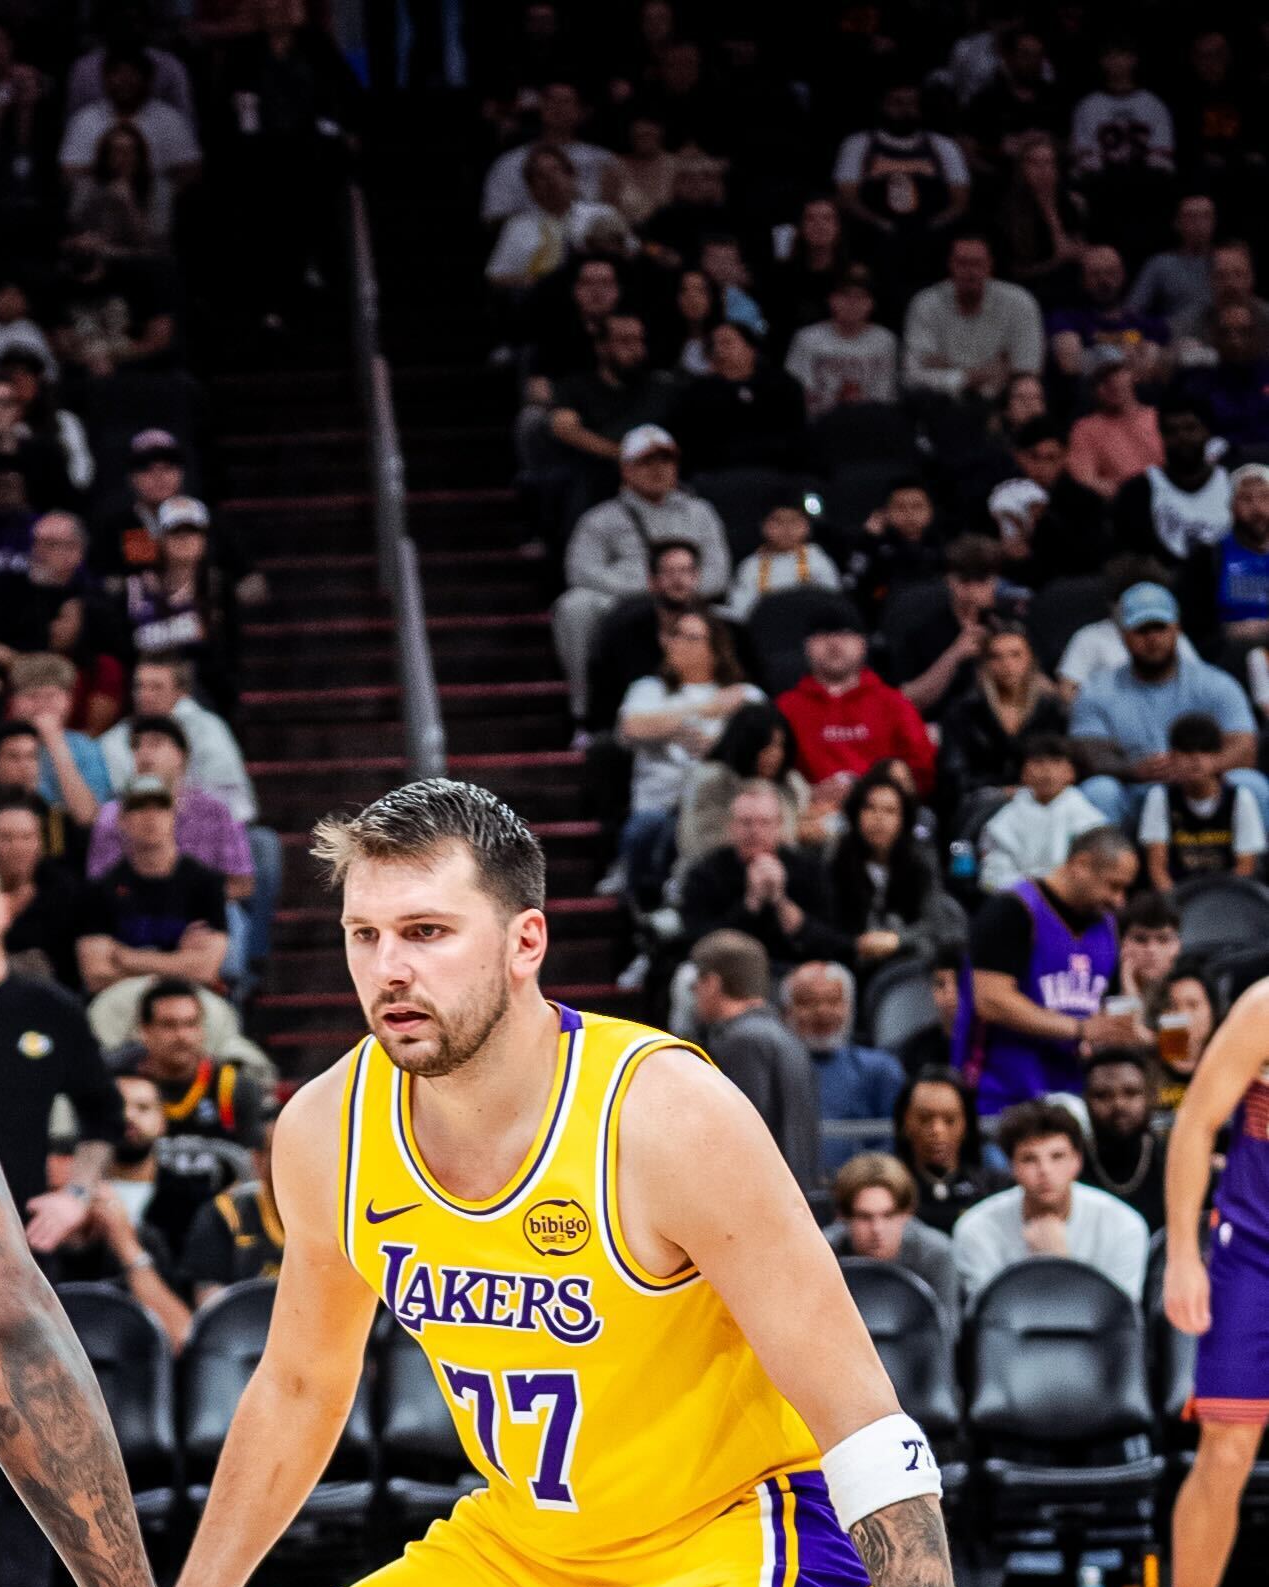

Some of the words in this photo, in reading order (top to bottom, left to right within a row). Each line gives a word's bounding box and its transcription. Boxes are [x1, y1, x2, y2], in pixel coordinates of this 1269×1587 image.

[529, 1214, 587, 1239] bibigo
[379, 1241, 604, 1346] LAKERS
[435, 1356, 584, 1513] 77
